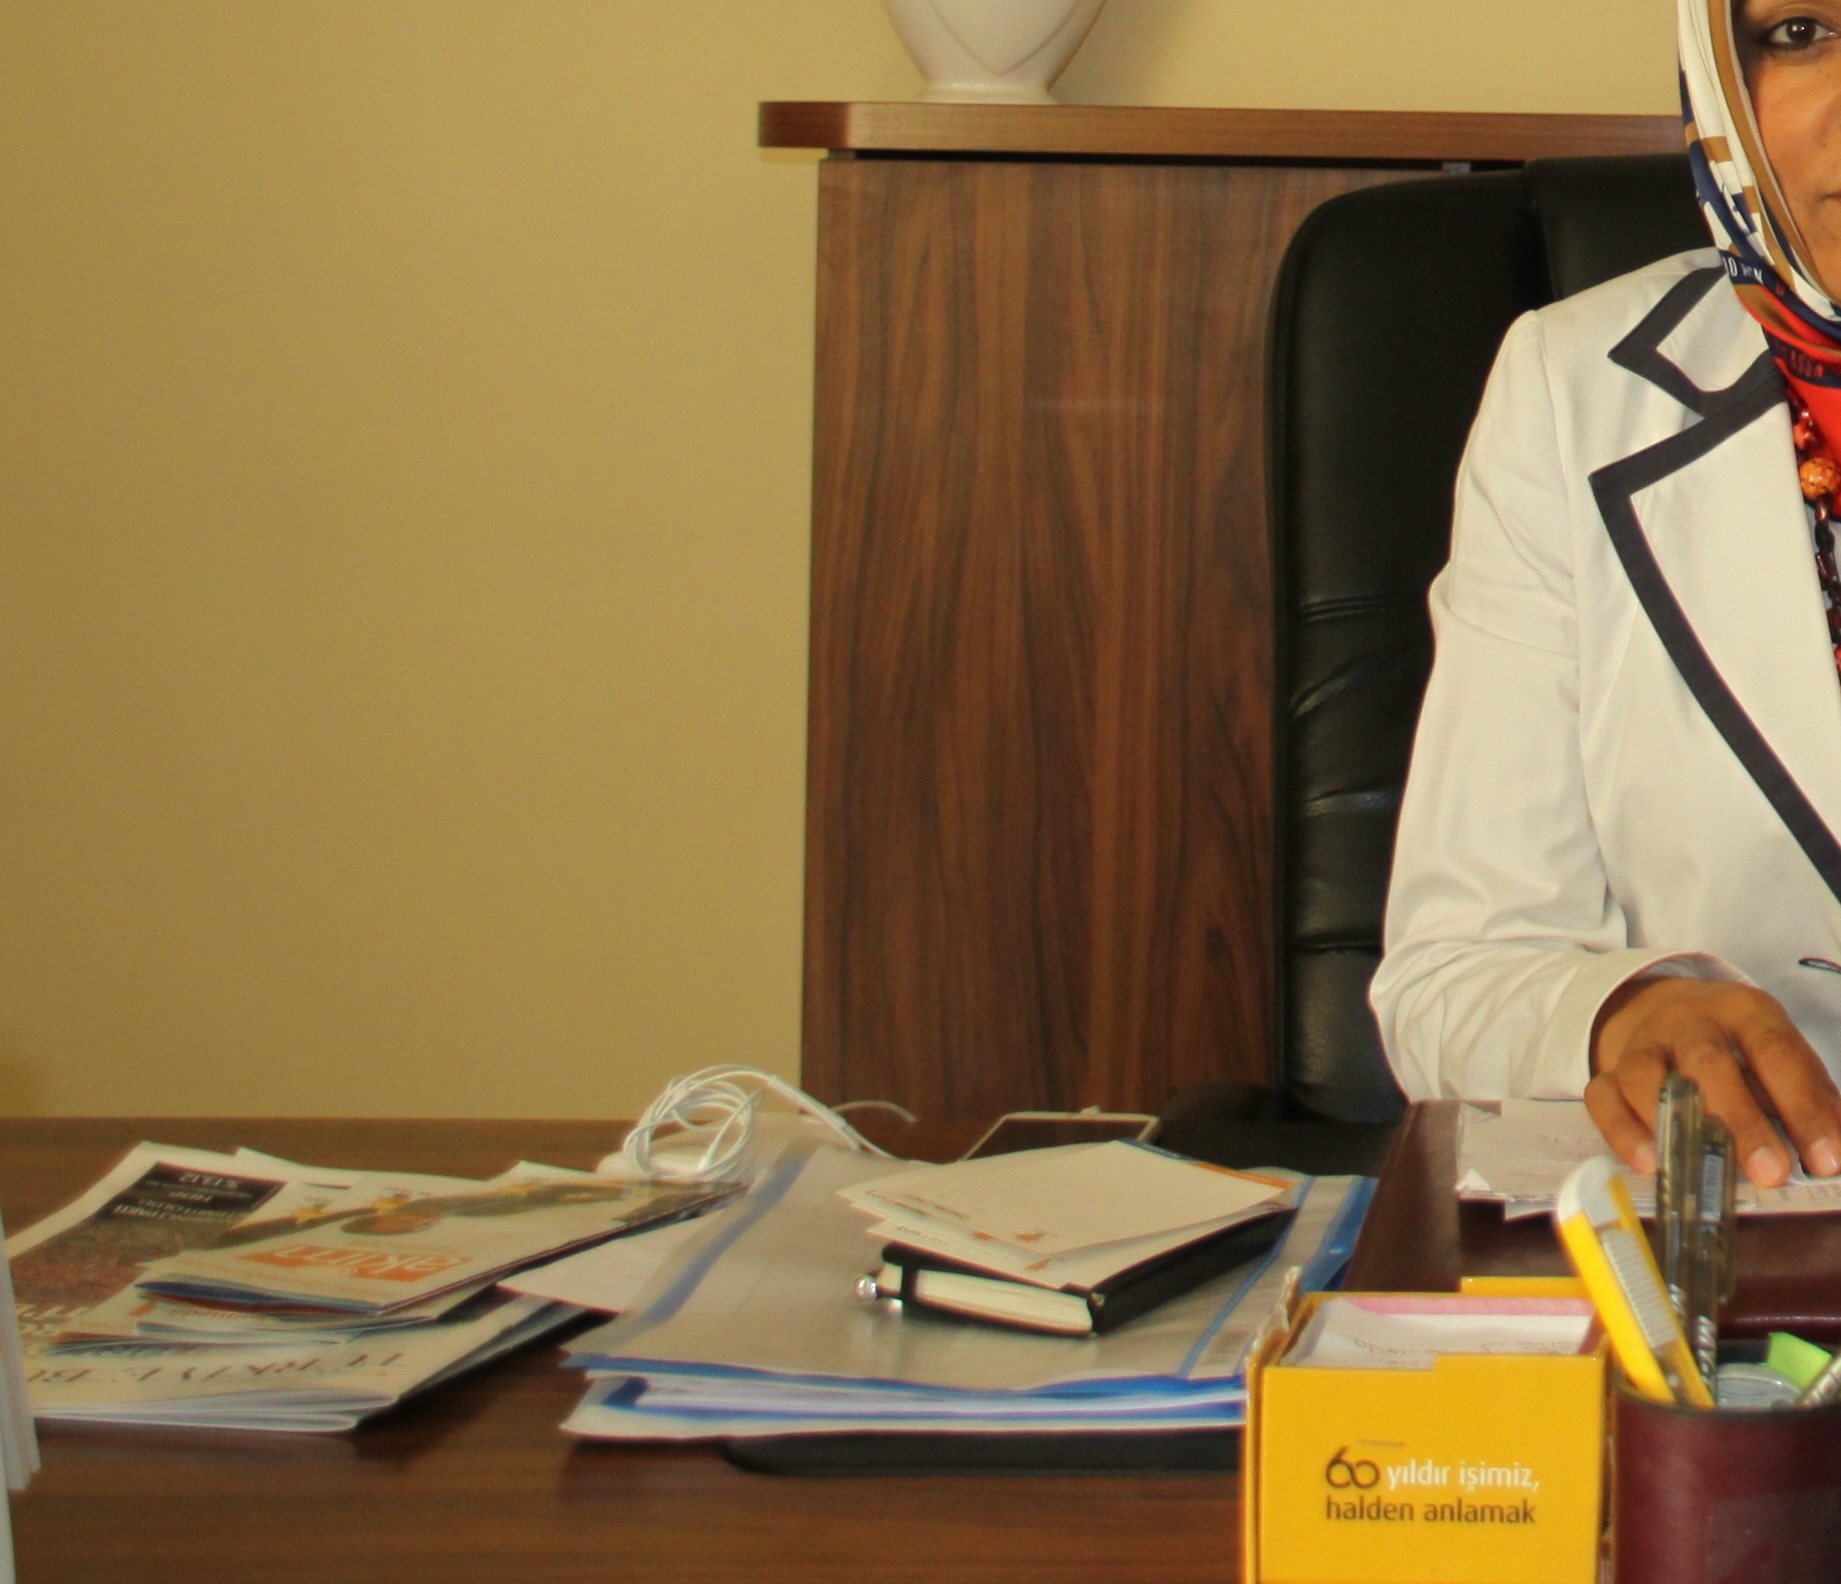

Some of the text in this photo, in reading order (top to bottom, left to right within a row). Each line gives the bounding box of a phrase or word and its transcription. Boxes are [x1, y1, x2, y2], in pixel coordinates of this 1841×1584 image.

[1386, 1458, 1451, 1492] yıldır
[1459, 1461, 1541, 1493] işimiz,
[1326, 1494, 1537, 1524] halden anlamak
